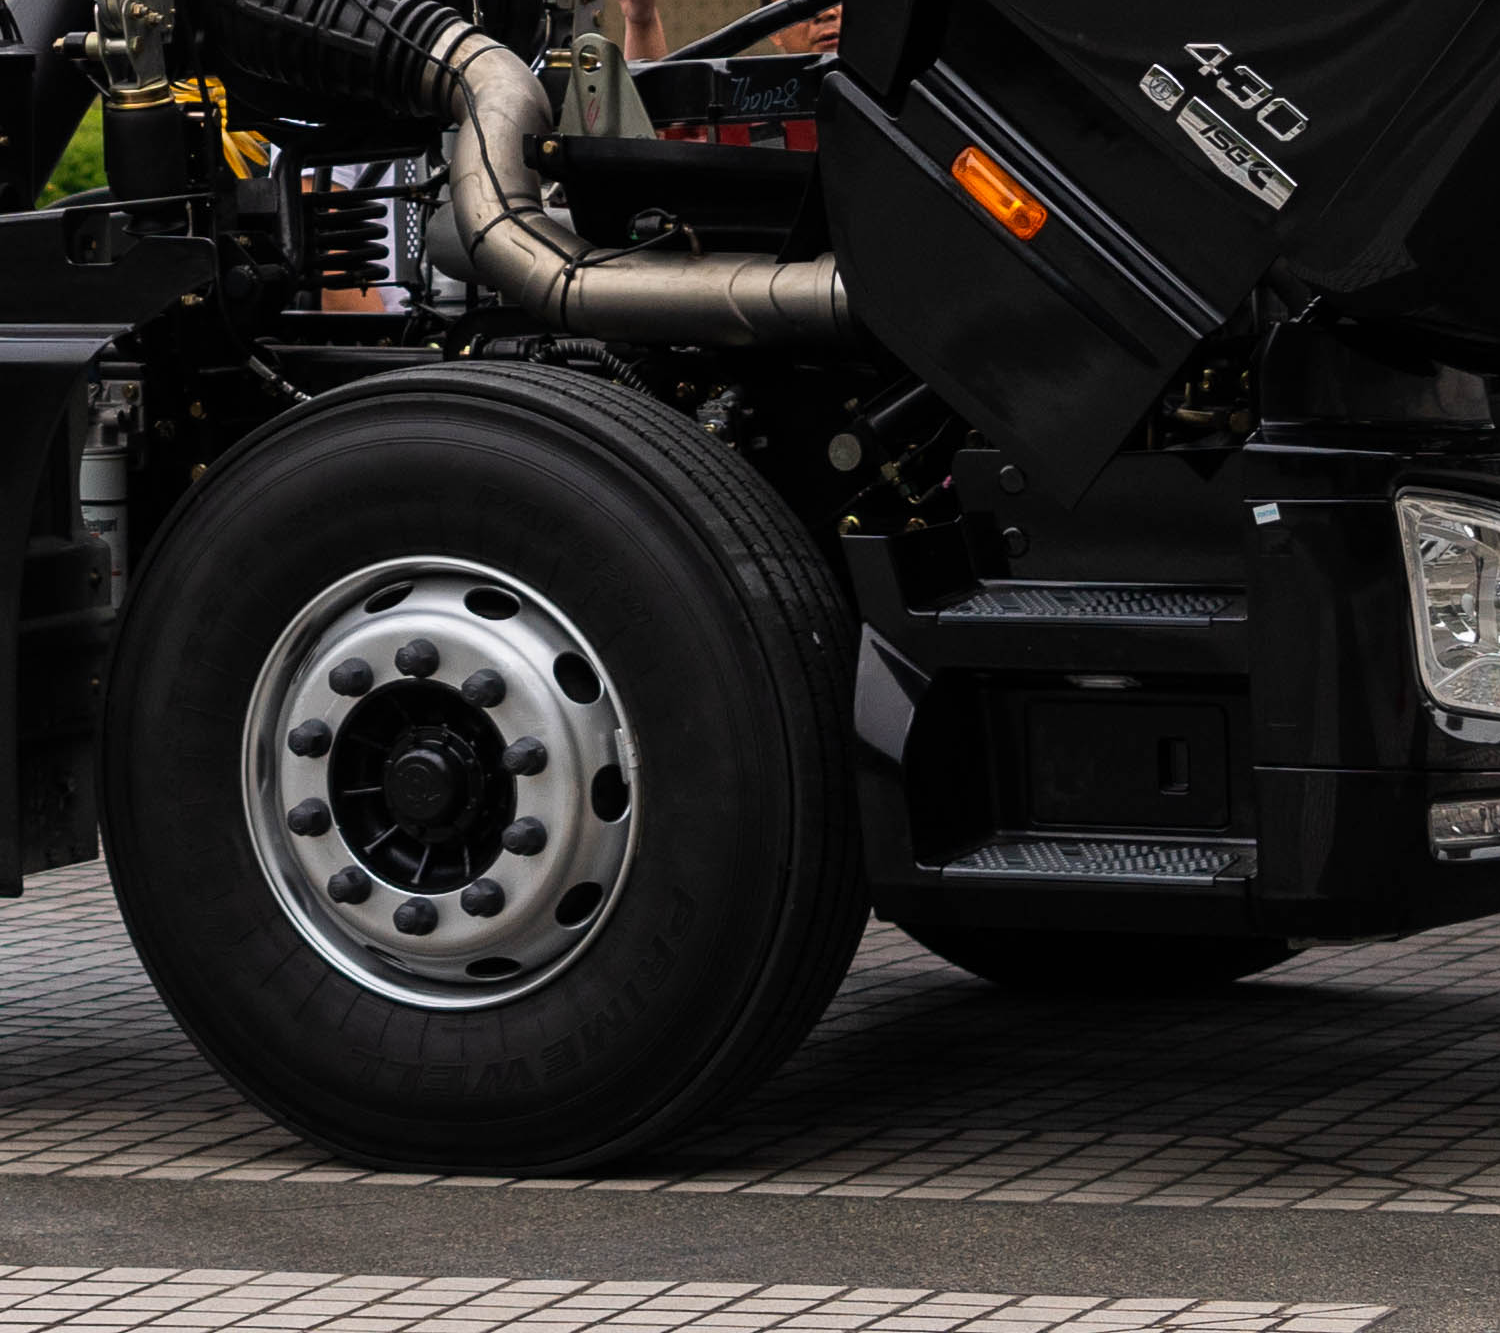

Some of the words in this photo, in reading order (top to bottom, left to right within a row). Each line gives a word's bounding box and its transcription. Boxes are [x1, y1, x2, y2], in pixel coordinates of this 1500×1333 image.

[1183, 43, 1310, 142] 430
[1199, 124, 1250, 165] ISG
[342, 885, 697, 1099] PRIMEWELL
